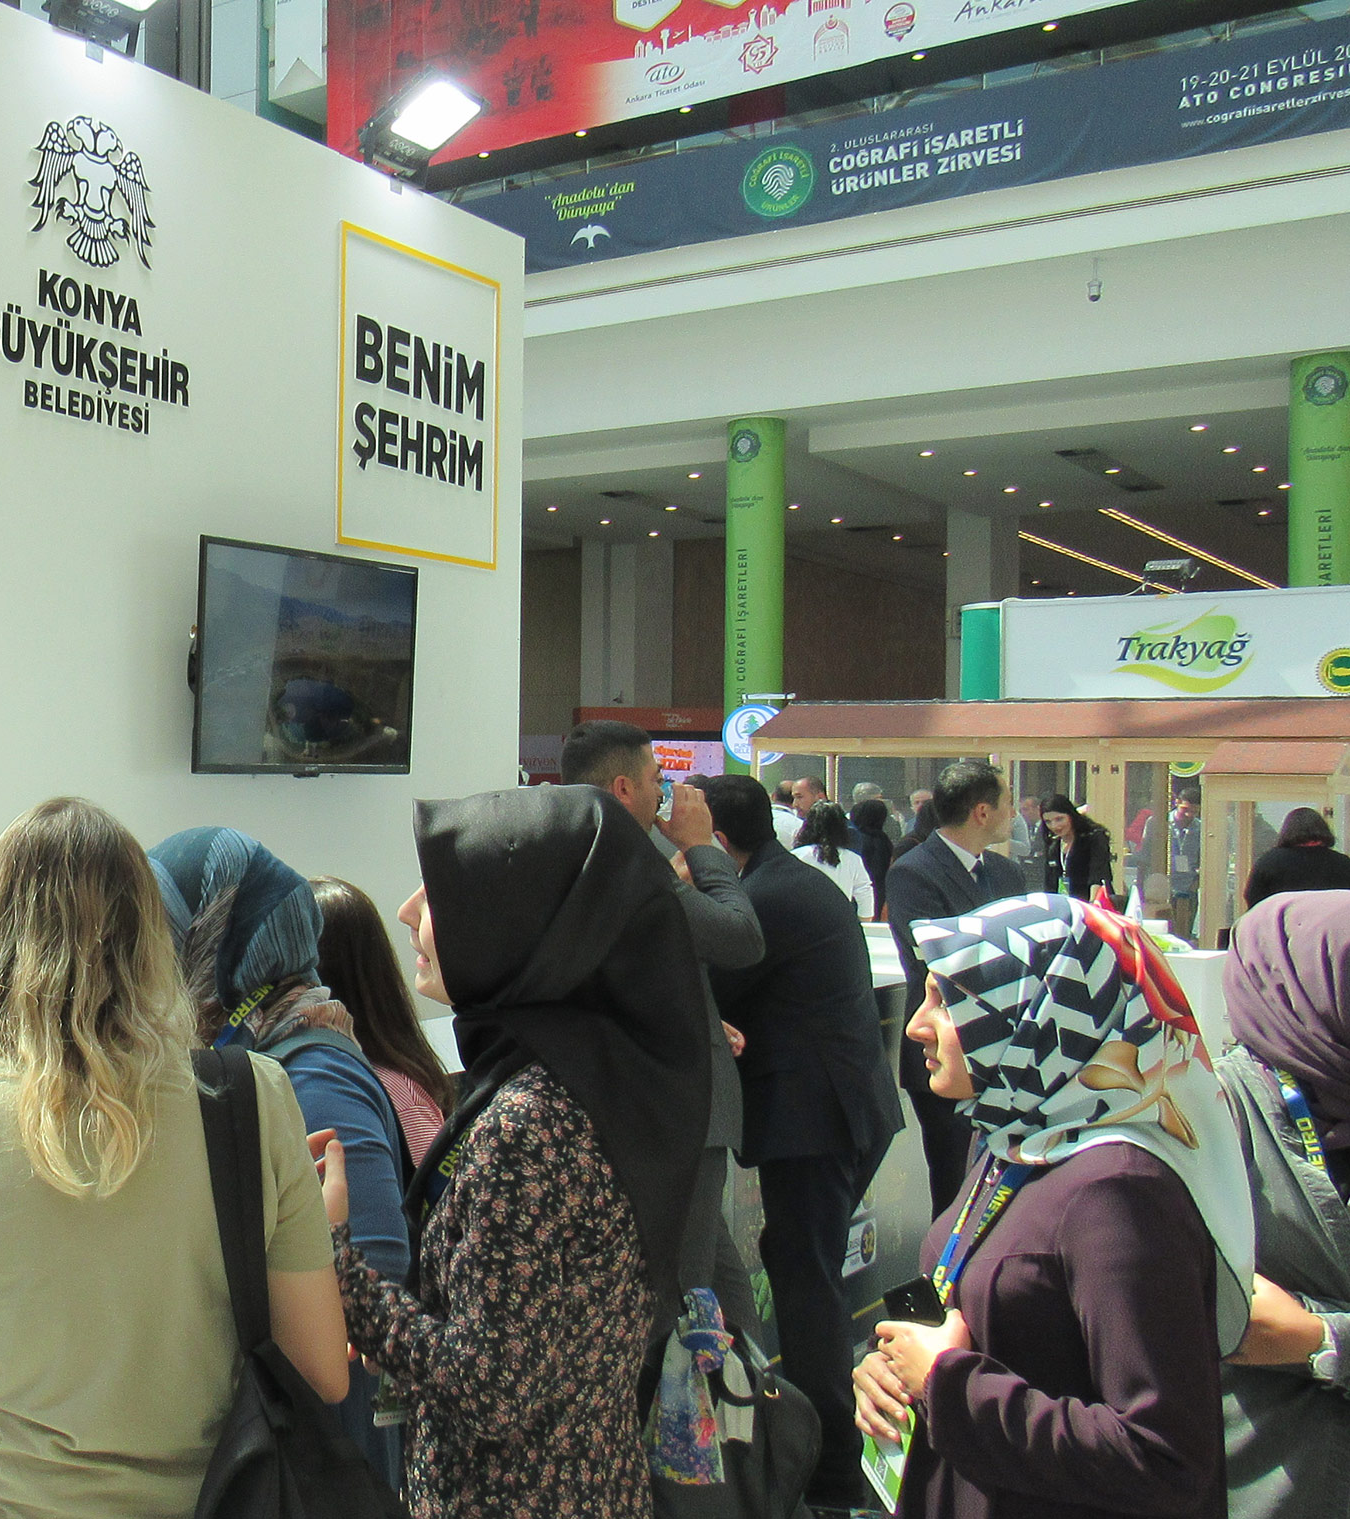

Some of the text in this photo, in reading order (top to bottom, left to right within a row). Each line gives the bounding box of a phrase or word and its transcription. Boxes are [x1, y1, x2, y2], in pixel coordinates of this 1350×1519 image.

[650, 64, 680, 83] ato
[1178, 63, 1350, 110] ATO CONGRESI
[1180, 63, 1259, 92] 19-20-21
[1267, 49, 1329, 75] EYLÜL
[625, 93, 652, 105] Ankara
[655, 85, 681, 98] Ticaret
[830, 122, 934, 153] 2. ULUSLARARASI
[831, 162, 930, 196] ÜRÜNLER
[37, 267, 143, 337] KONYA
[23, 379, 151, 436] BELEDİYESİ
[1116, 632, 1250, 667] Trakyağ
[229, 983, 275, 1027] METRO
[1296, 1117, 1327, 1170] ETRO
